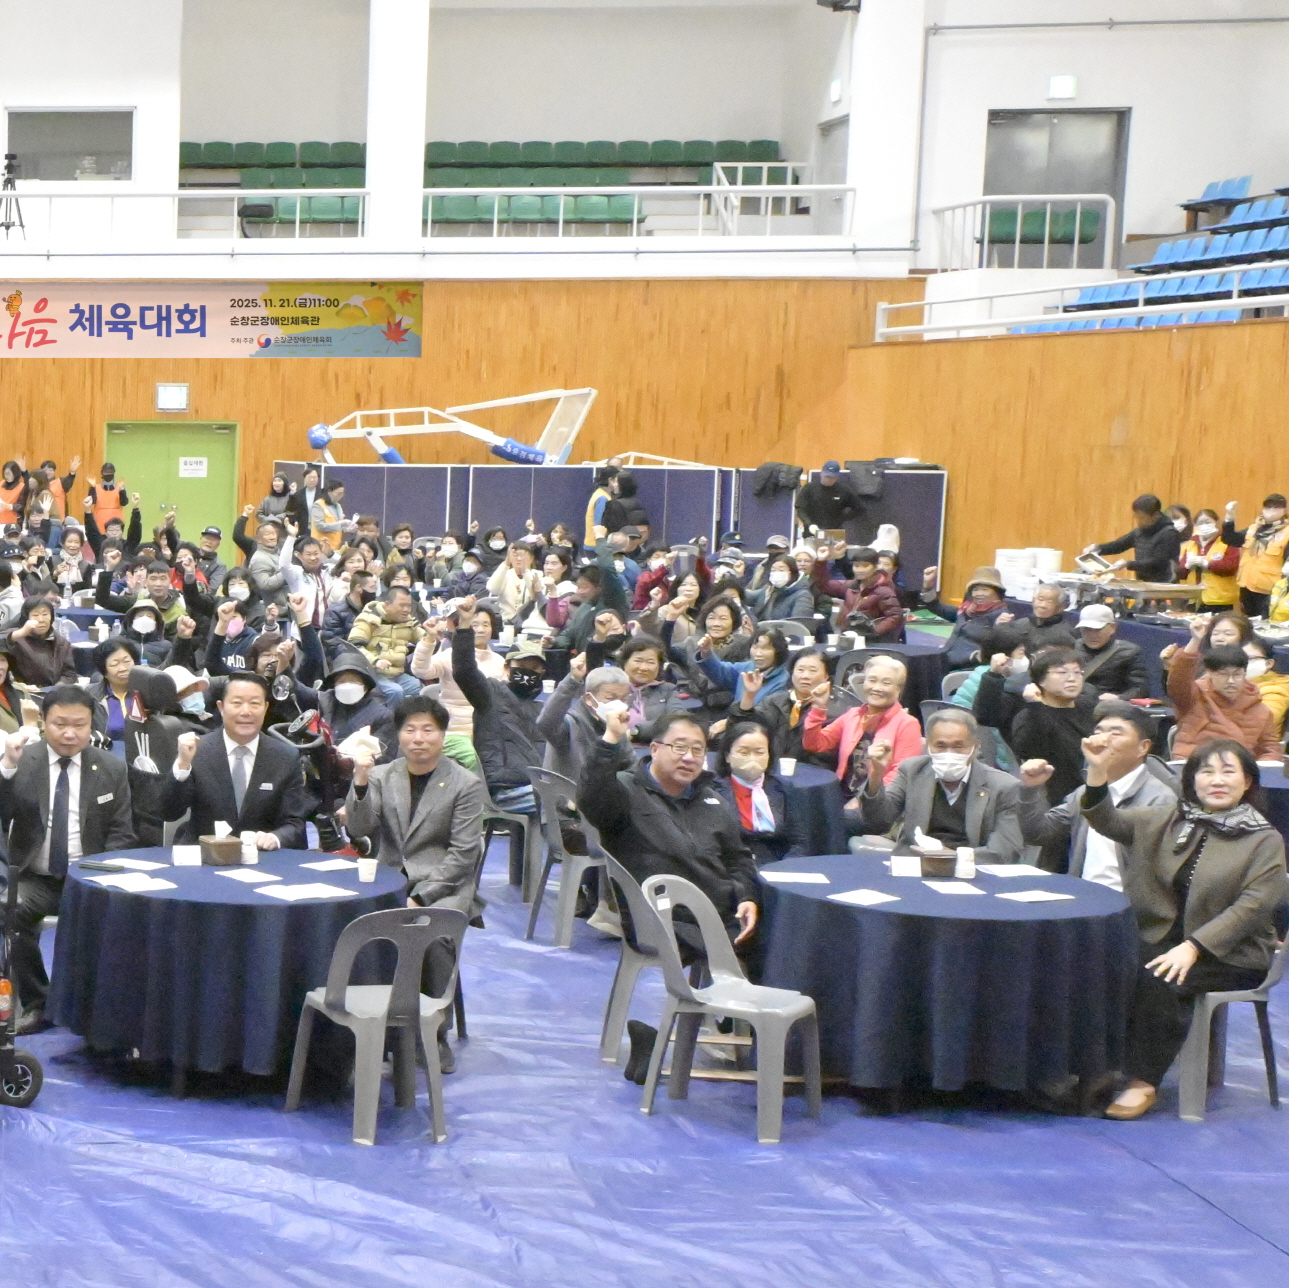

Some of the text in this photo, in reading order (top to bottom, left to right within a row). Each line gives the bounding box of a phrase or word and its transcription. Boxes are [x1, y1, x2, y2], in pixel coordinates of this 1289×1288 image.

[229, 298, 261, 308] 2025.
[264, 298, 276, 308] 11.
[68, 302, 207, 340] 체육대회
[230, 316, 320, 326] 순창군장애인체육관
[274, 336, 332, 344] 순창군장애인체육회
